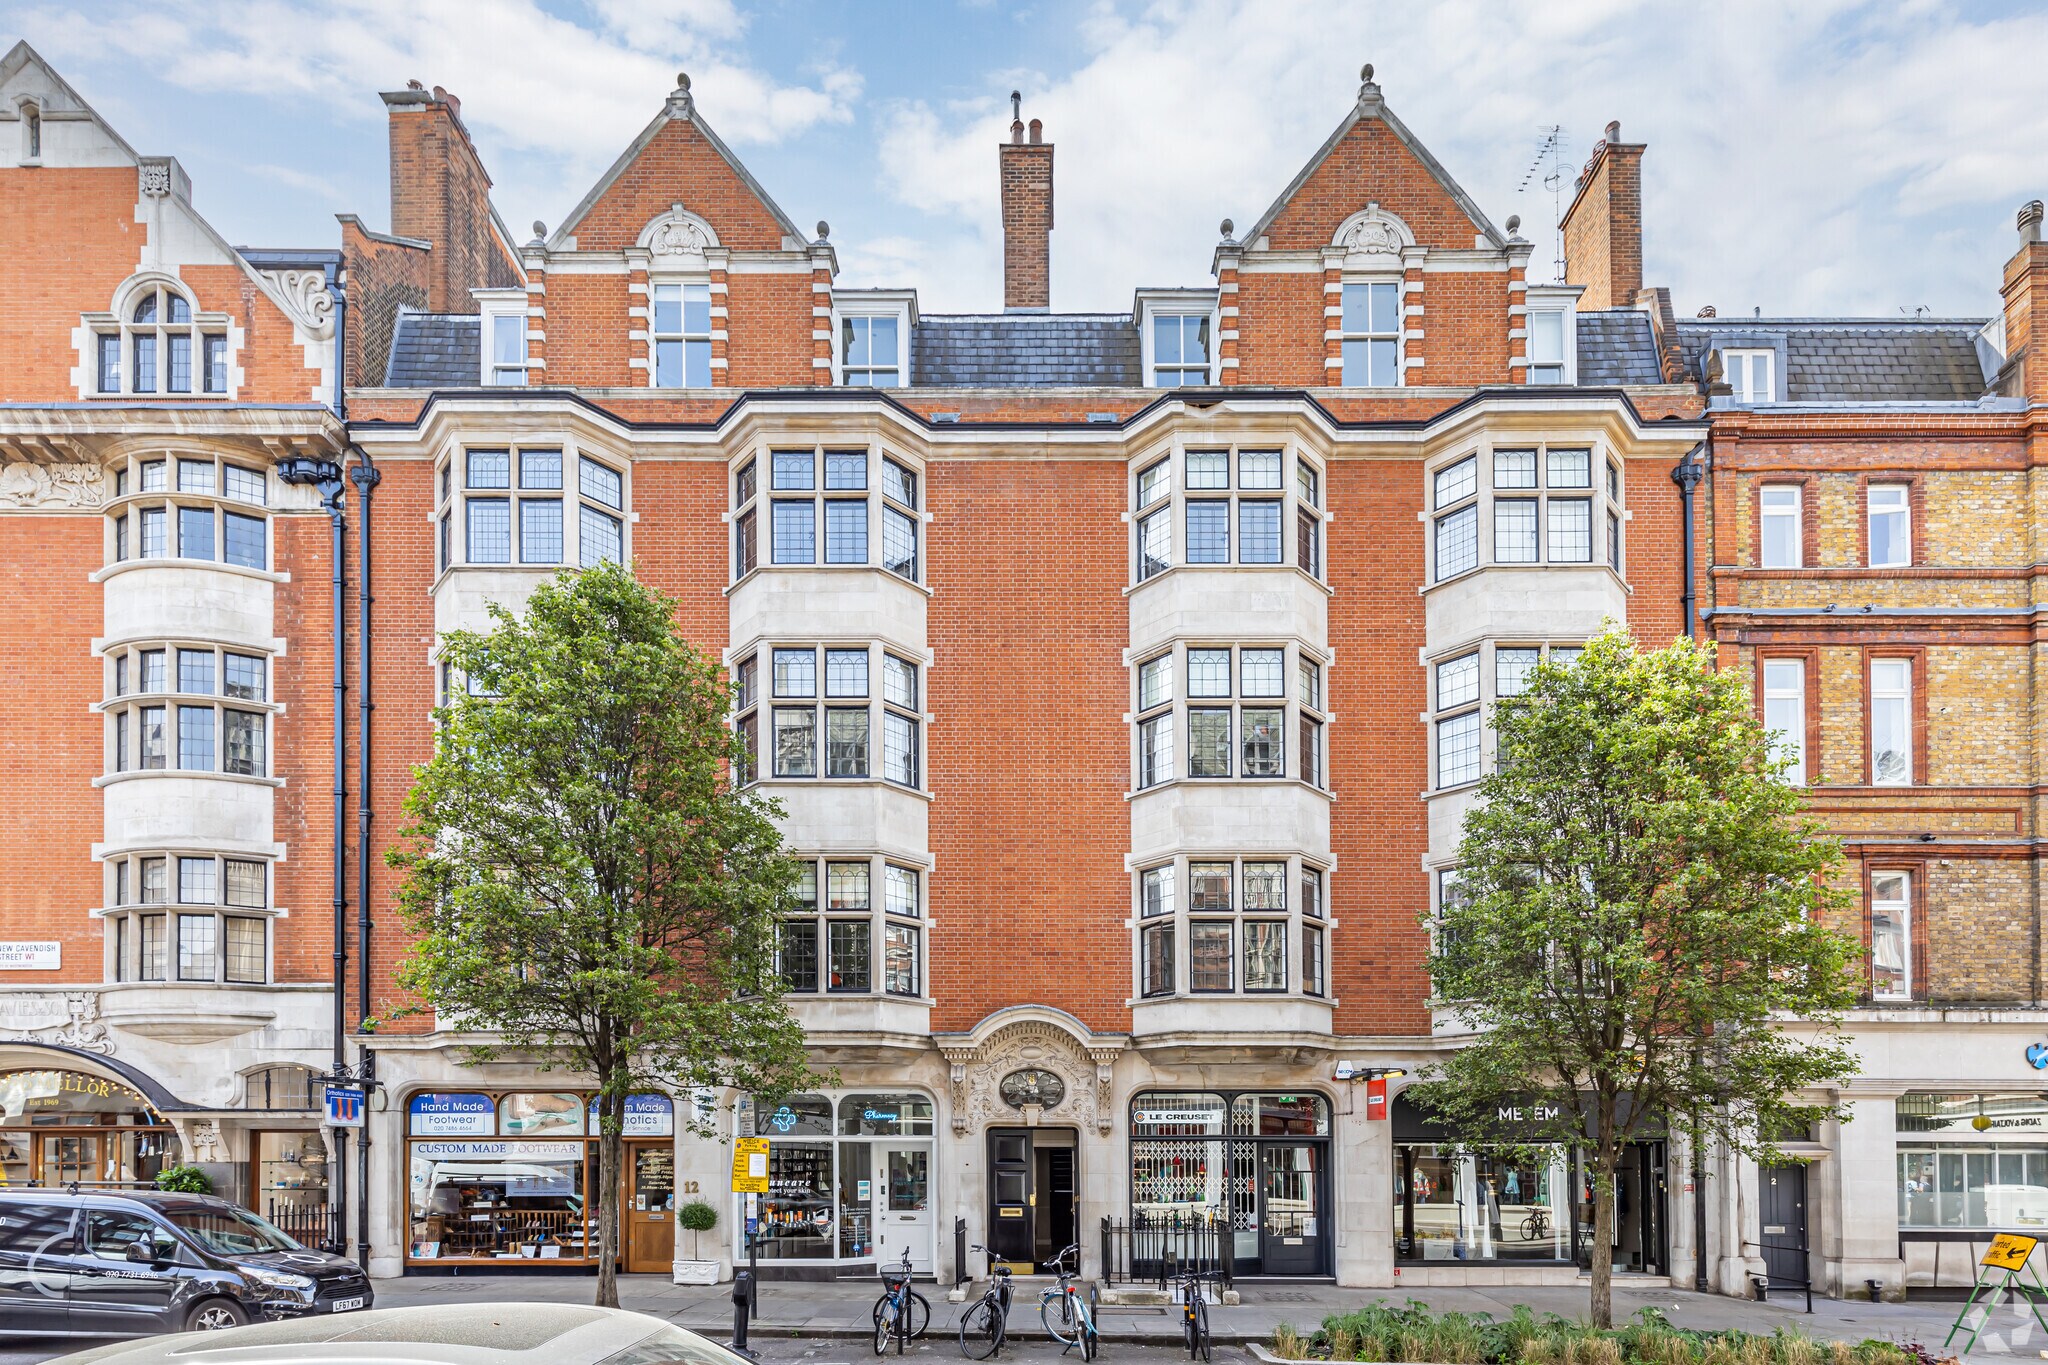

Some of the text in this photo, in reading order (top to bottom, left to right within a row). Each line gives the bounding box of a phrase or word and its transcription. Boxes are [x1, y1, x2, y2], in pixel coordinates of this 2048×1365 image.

[16, 944, 56, 952] CAVENDISH
[421, 1102, 484, 1111] Hand Made
[636, 1103, 665, 1112] Made
[864, 1110, 898, 1121] Pharmacy
[1498, 1107, 1559, 1121] MEEM
[429, 1115, 476, 1124] Footwear
[624, 1115, 658, 1125] otics
[418, 1144, 466, 1153] CUSTOM
[472, 1144, 506, 1153] MADE
[684, 1180, 699, 1194] 12
[105, 1270, 119, 1278] 020
